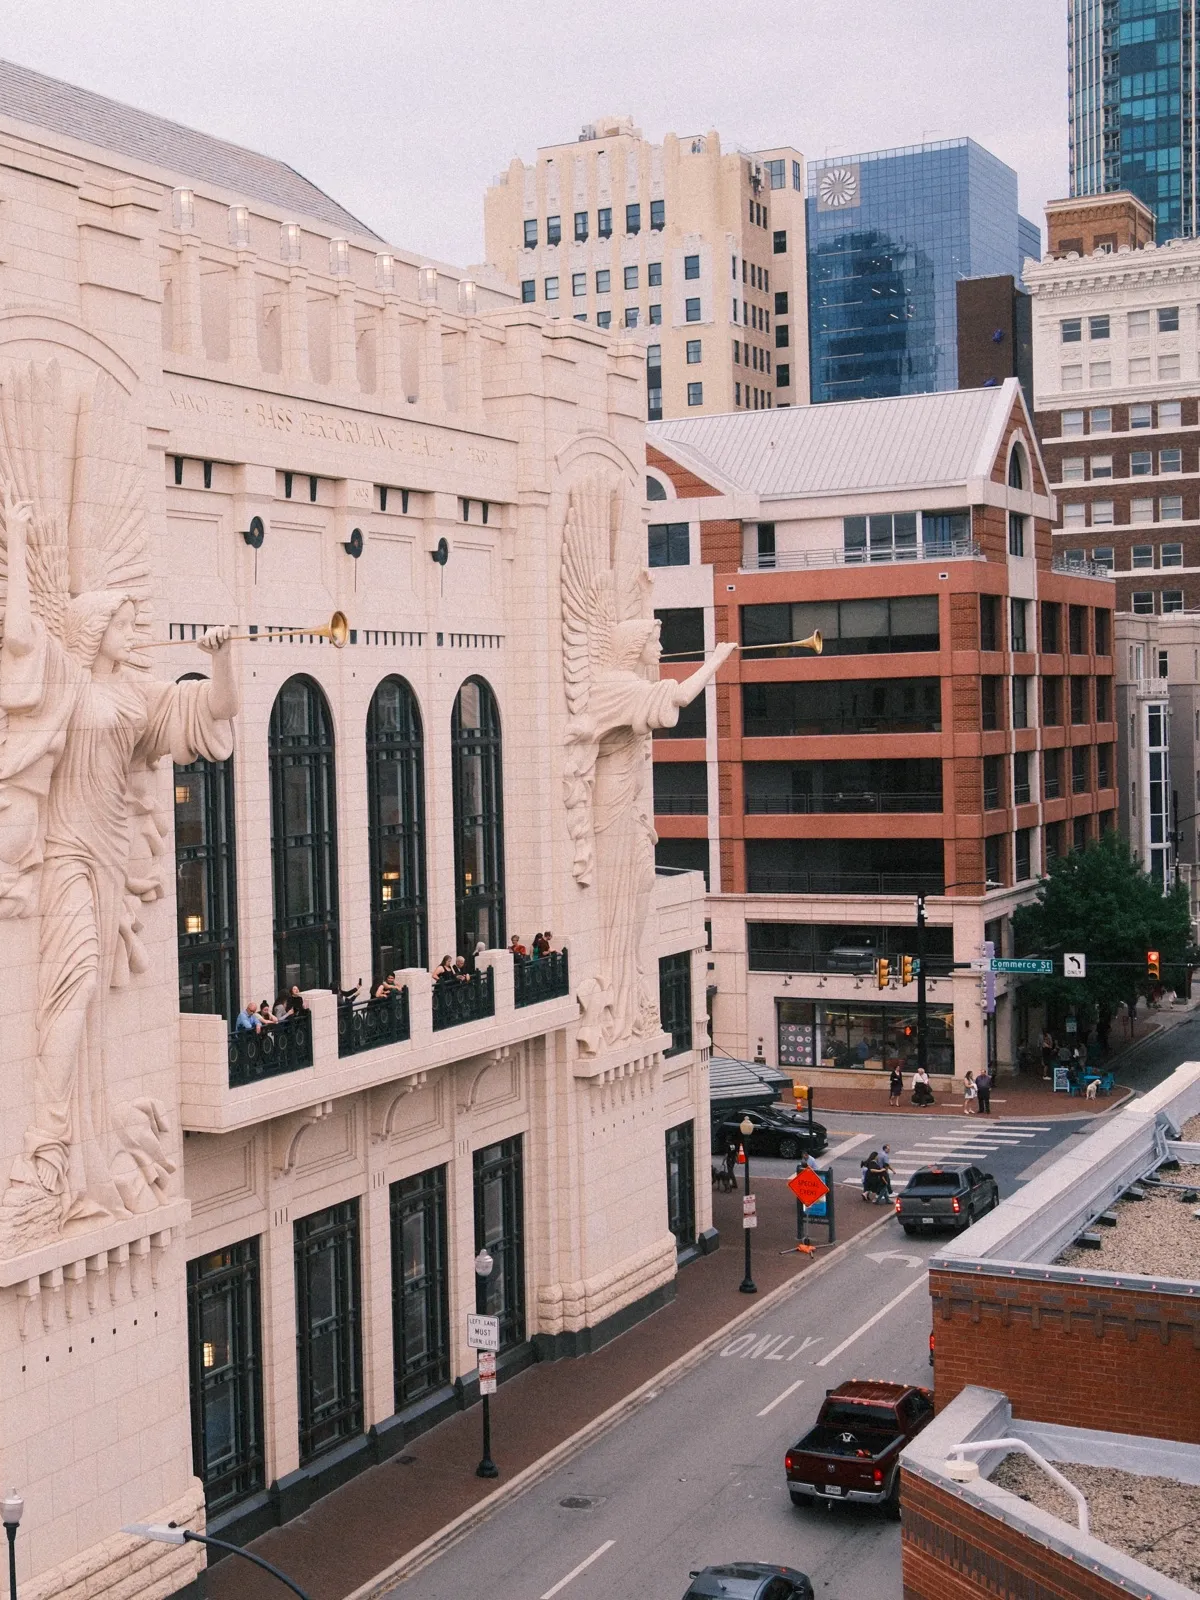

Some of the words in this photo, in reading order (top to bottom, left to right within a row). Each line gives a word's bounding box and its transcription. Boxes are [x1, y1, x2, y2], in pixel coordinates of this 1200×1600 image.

[255, 403, 293, 432] BASS
[992, 960, 1037, 969] Commerce
[1040, 961, 1051, 969] St
[798, 1180, 819, 1189] SPECIAL
[484, 1320, 497, 1328] LANE
[474, 1328, 491, 1337] MUST
[470, 1337, 483, 1345] TURN
[485, 1339, 497, 1347] LEFT
[720, 1333, 824, 1361] ONLY
